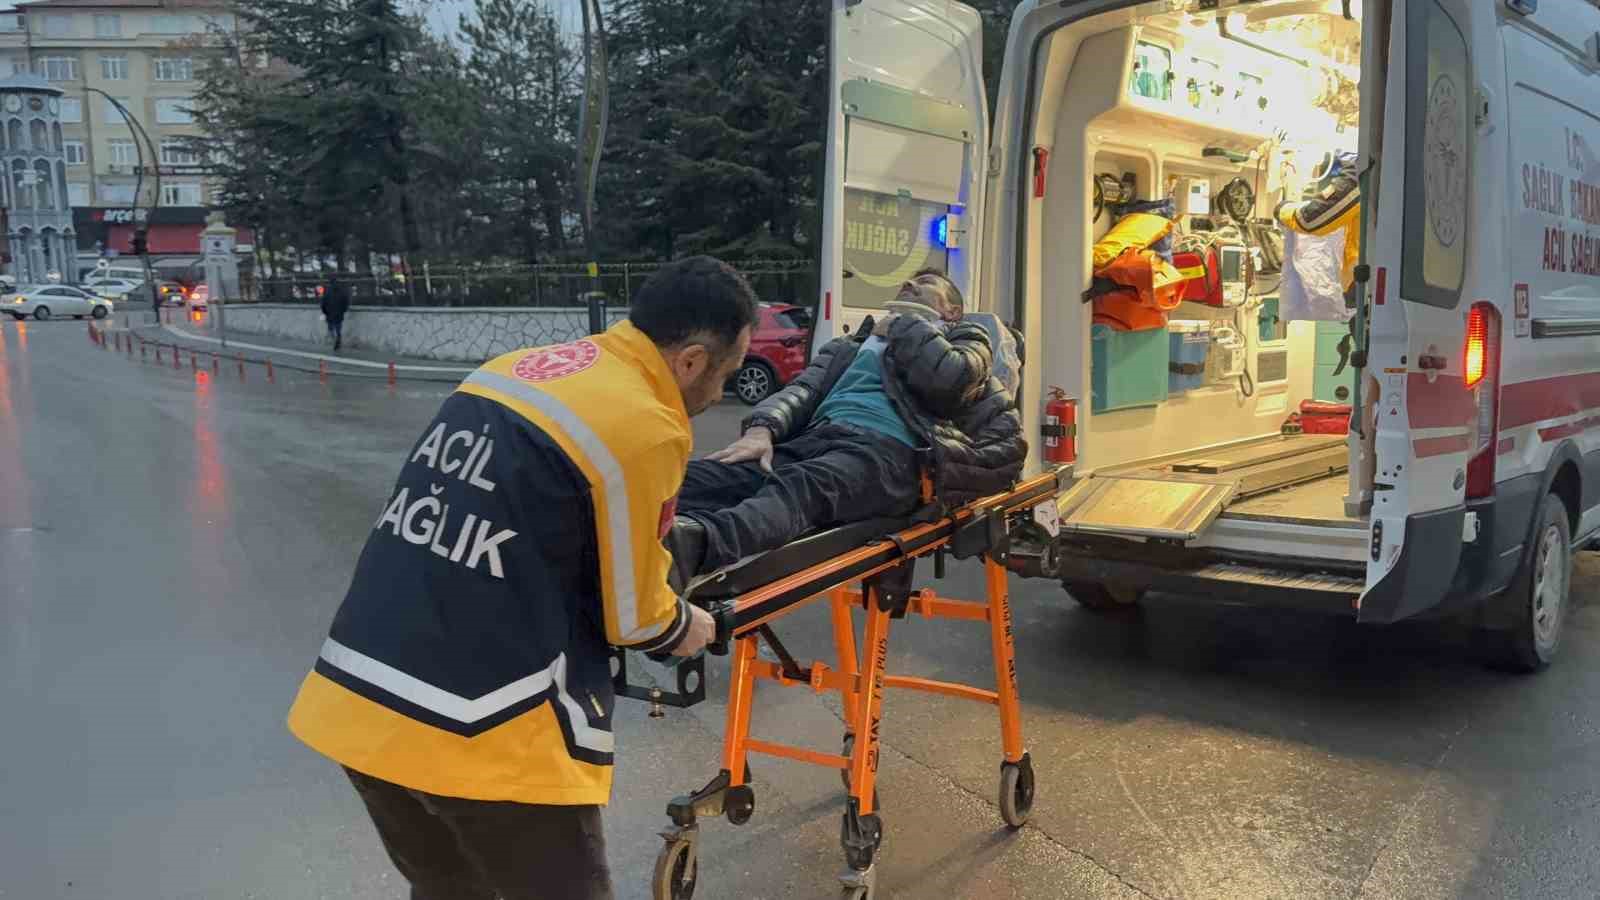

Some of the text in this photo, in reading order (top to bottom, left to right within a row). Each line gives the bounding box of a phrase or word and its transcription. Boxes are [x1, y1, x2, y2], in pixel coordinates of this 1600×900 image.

[1522, 162, 1564, 216] SAĞLIK
[1543, 222, 1566, 272] ACİL
[411, 422, 496, 492] ACİL
[375, 483, 519, 579] AĞLIK
